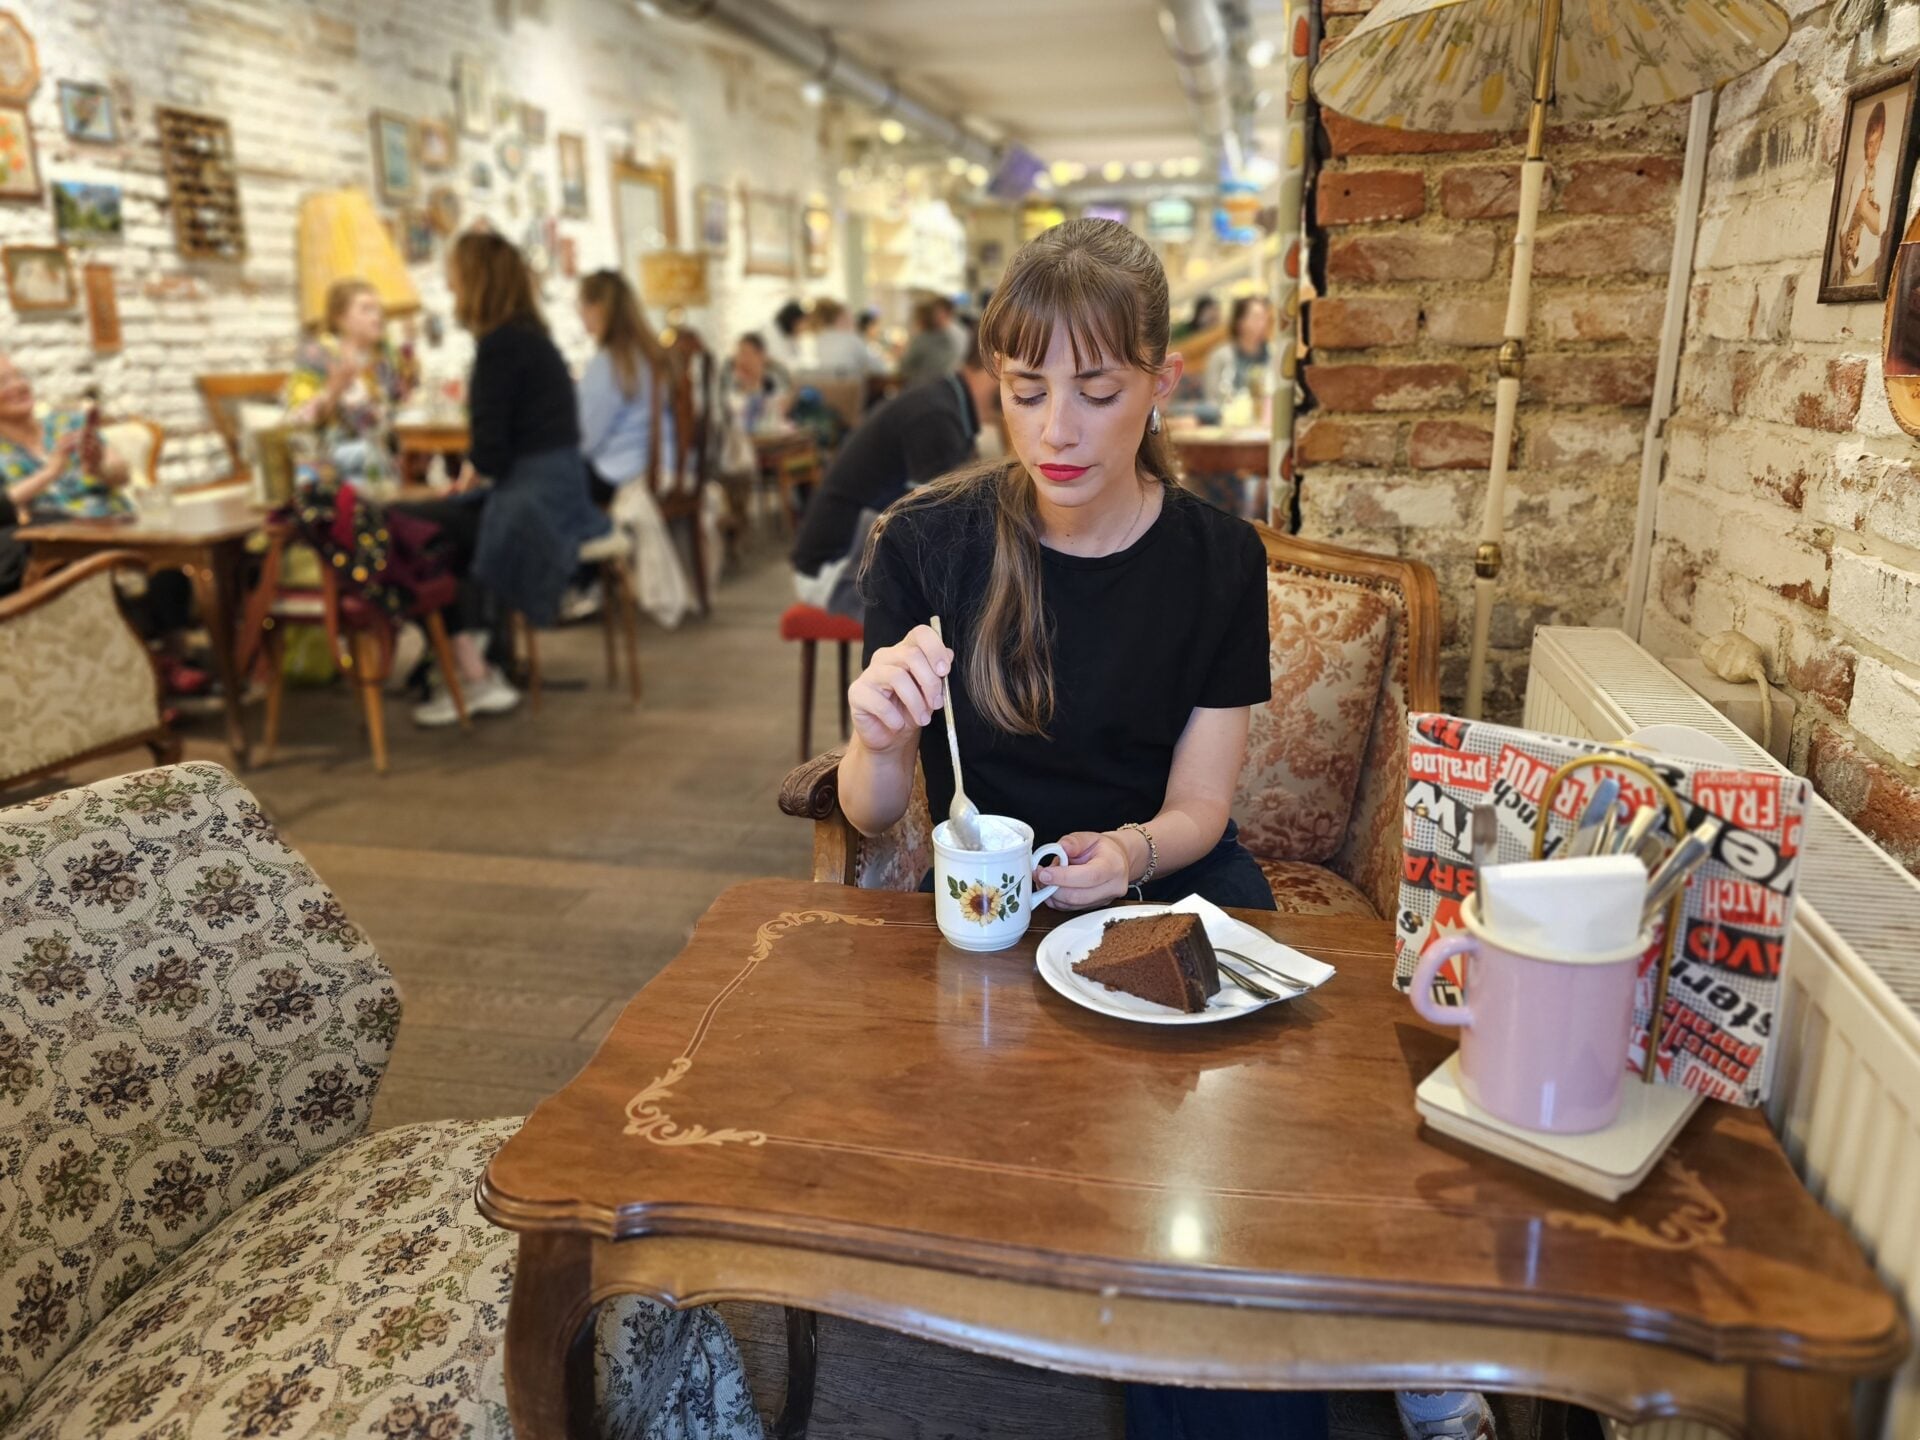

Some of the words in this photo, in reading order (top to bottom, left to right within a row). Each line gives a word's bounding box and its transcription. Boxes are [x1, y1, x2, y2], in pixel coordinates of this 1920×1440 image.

[1411, 751, 1488, 783] praline
[1497, 748, 1580, 815] RVUE
[1697, 787, 1776, 827] FRAU
[1403, 853, 1476, 896] BRA
[1704, 879, 1783, 926] MATCH
